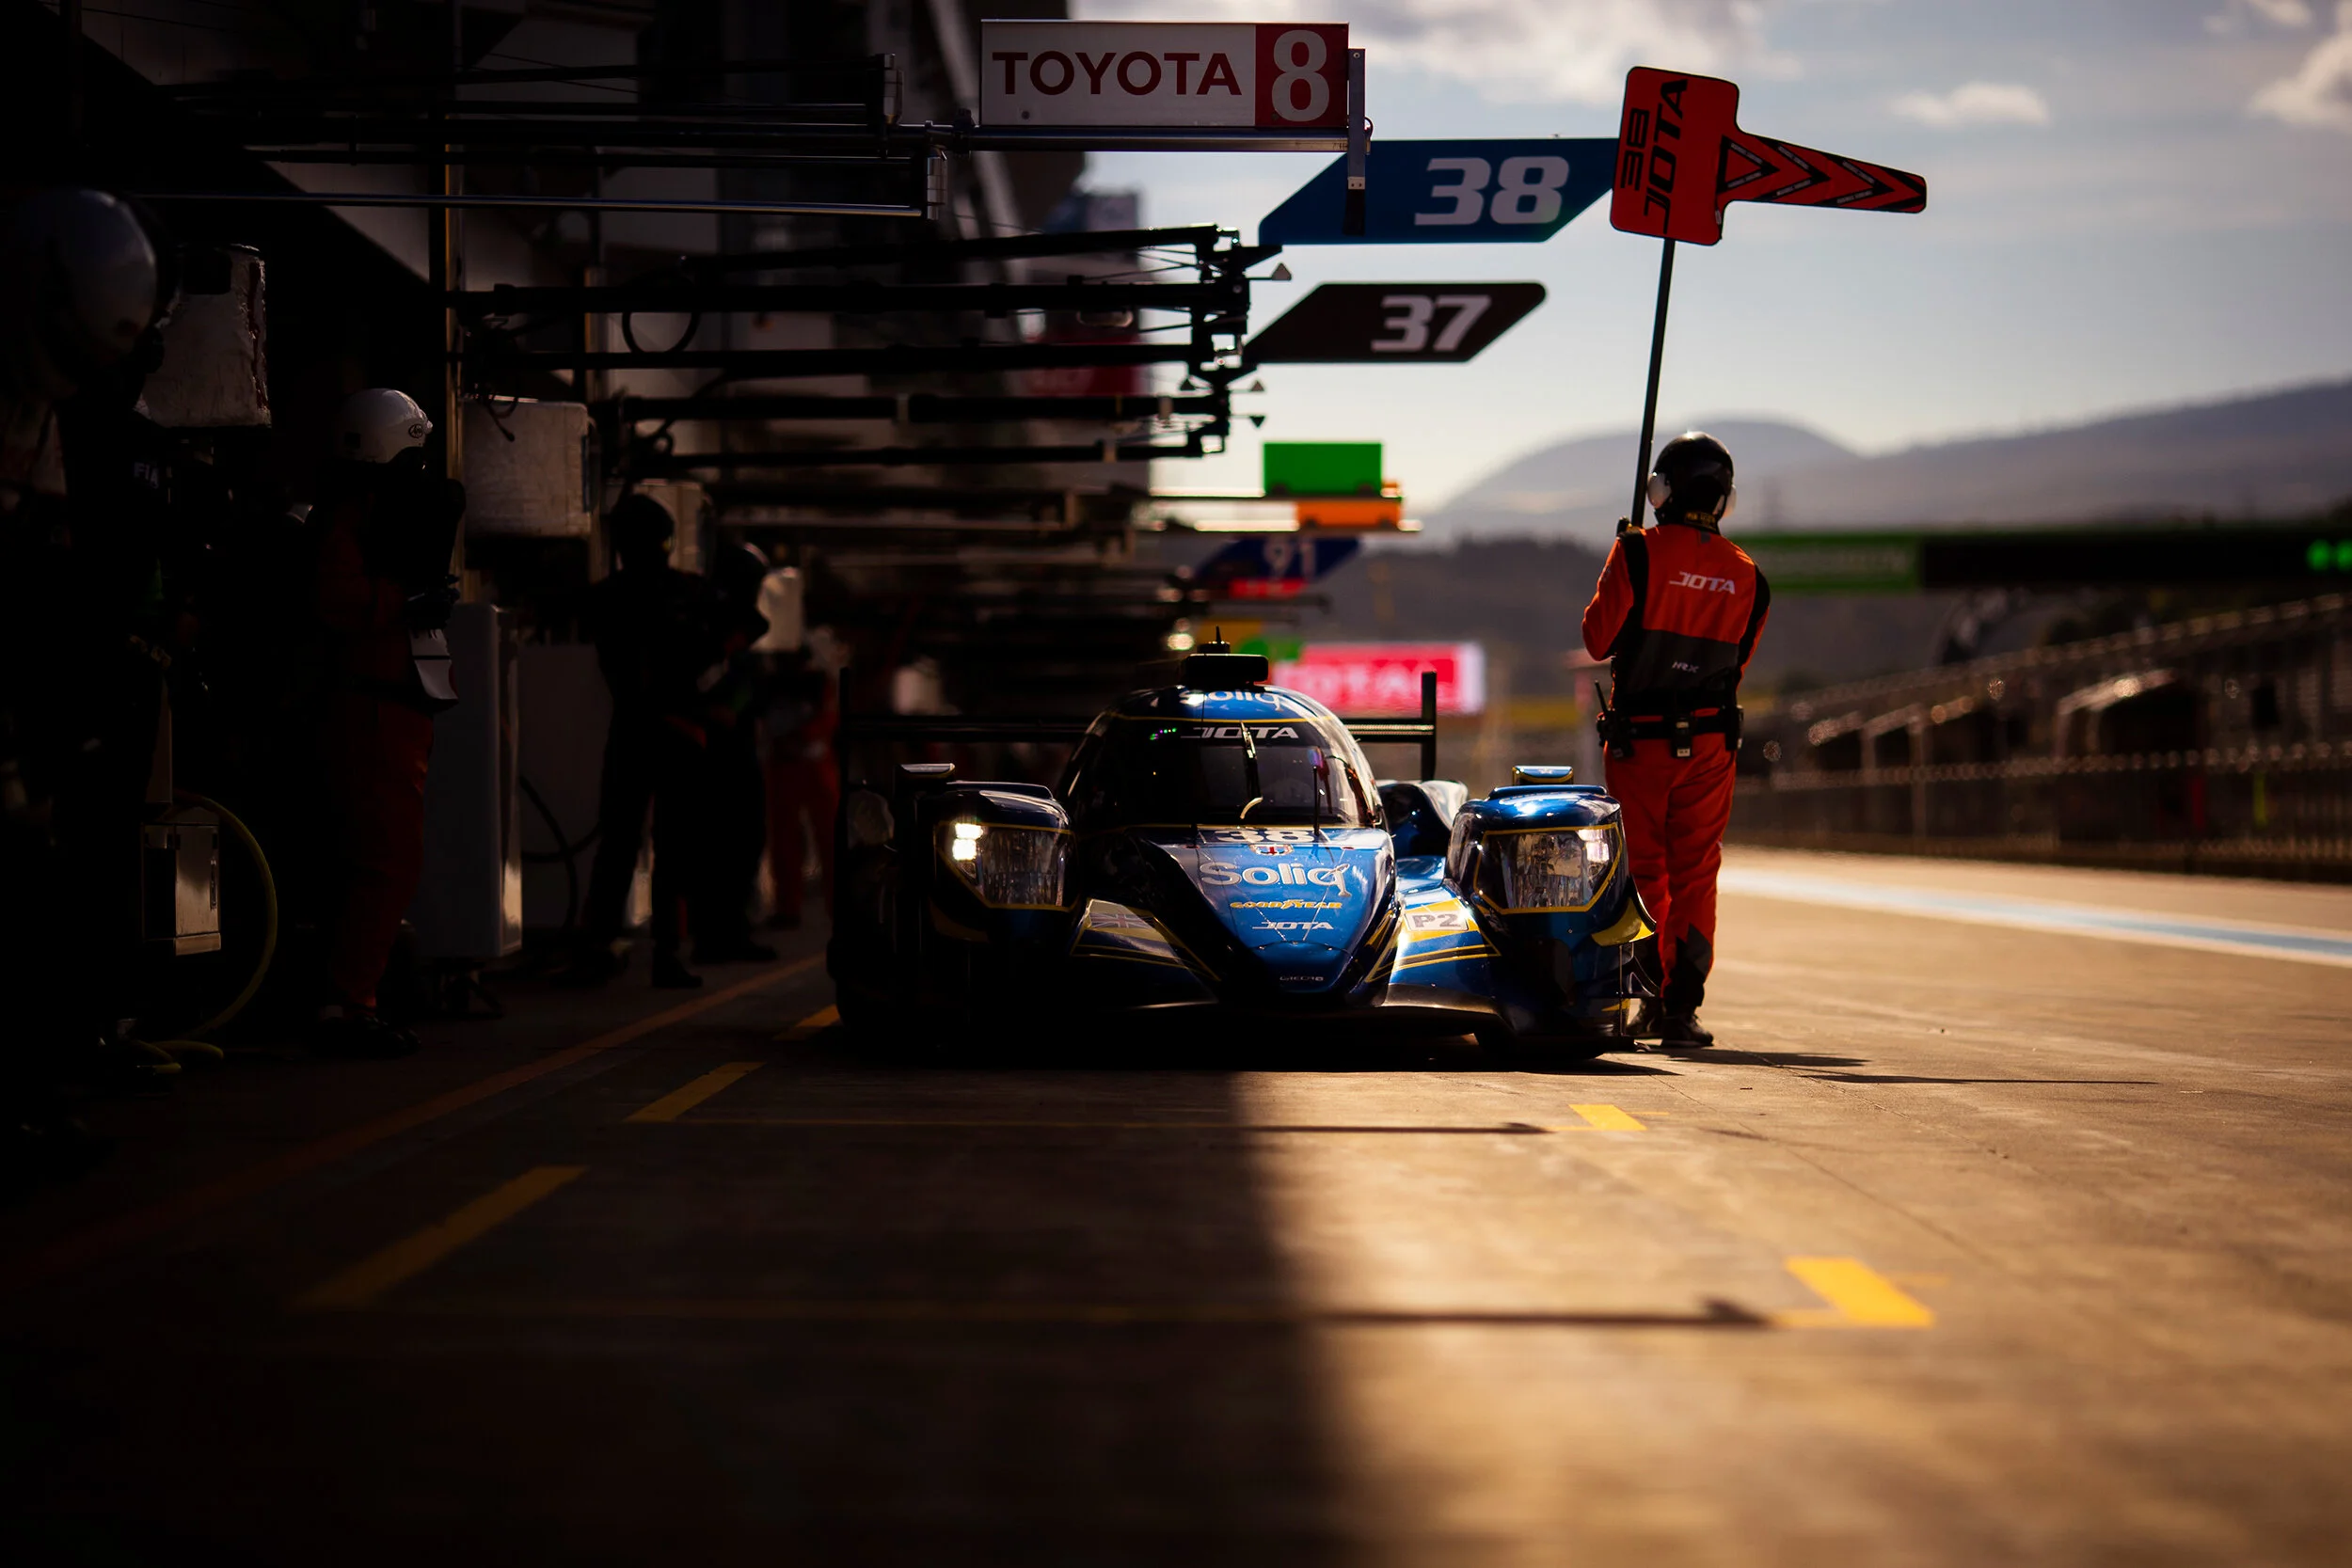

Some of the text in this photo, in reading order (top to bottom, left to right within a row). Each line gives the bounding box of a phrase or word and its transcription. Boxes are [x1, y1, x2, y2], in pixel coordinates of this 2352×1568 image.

[992, 50, 1242, 97] TOYOTA
[1271, 29, 1331, 122] 8
[1620, 107, 1650, 192] 38
[1644, 79, 1689, 235] JOTA
[1414, 155, 1570, 227] 38
[1371, 294, 1491, 354] 37
[1668, 570, 1736, 594] JOTA
[1180, 726, 1299, 739] JOTA
[1215, 829, 1314, 843] 38
[1230, 899, 1343, 910] GOODYEAR
[1412, 913, 1461, 928] P2
[1252, 921, 1334, 930] JOTA
